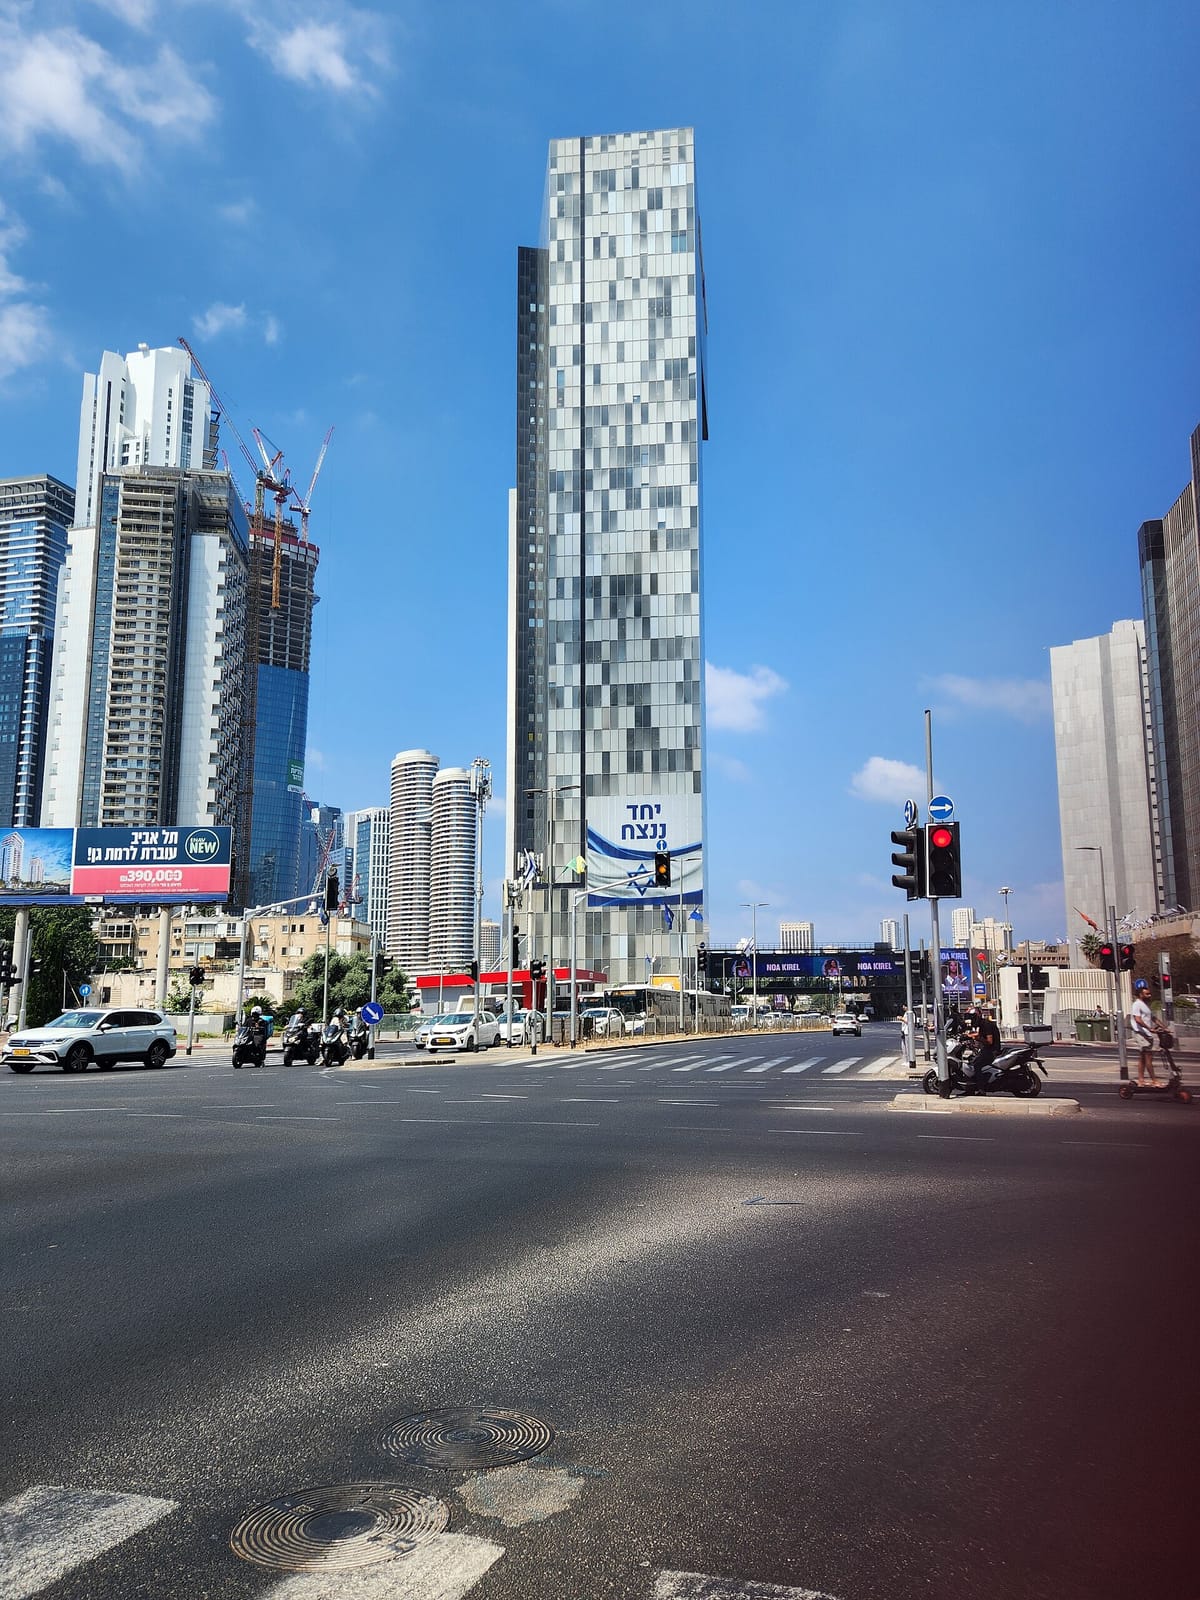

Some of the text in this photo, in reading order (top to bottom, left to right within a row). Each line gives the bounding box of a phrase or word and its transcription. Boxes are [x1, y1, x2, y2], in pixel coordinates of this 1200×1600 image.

[626, 804, 661, 820] יחד
[131, 829, 179, 845] תל אביב
[621, 823, 667, 840] ננצח
[87, 845, 178, 863] עוברת לרמת גן!
[190, 841, 217, 854] NEW
[951, 952, 968, 960] KIREL
[766, 963, 801, 971] NOA KIREL
[857, 962, 893, 970] NOA KIREL
